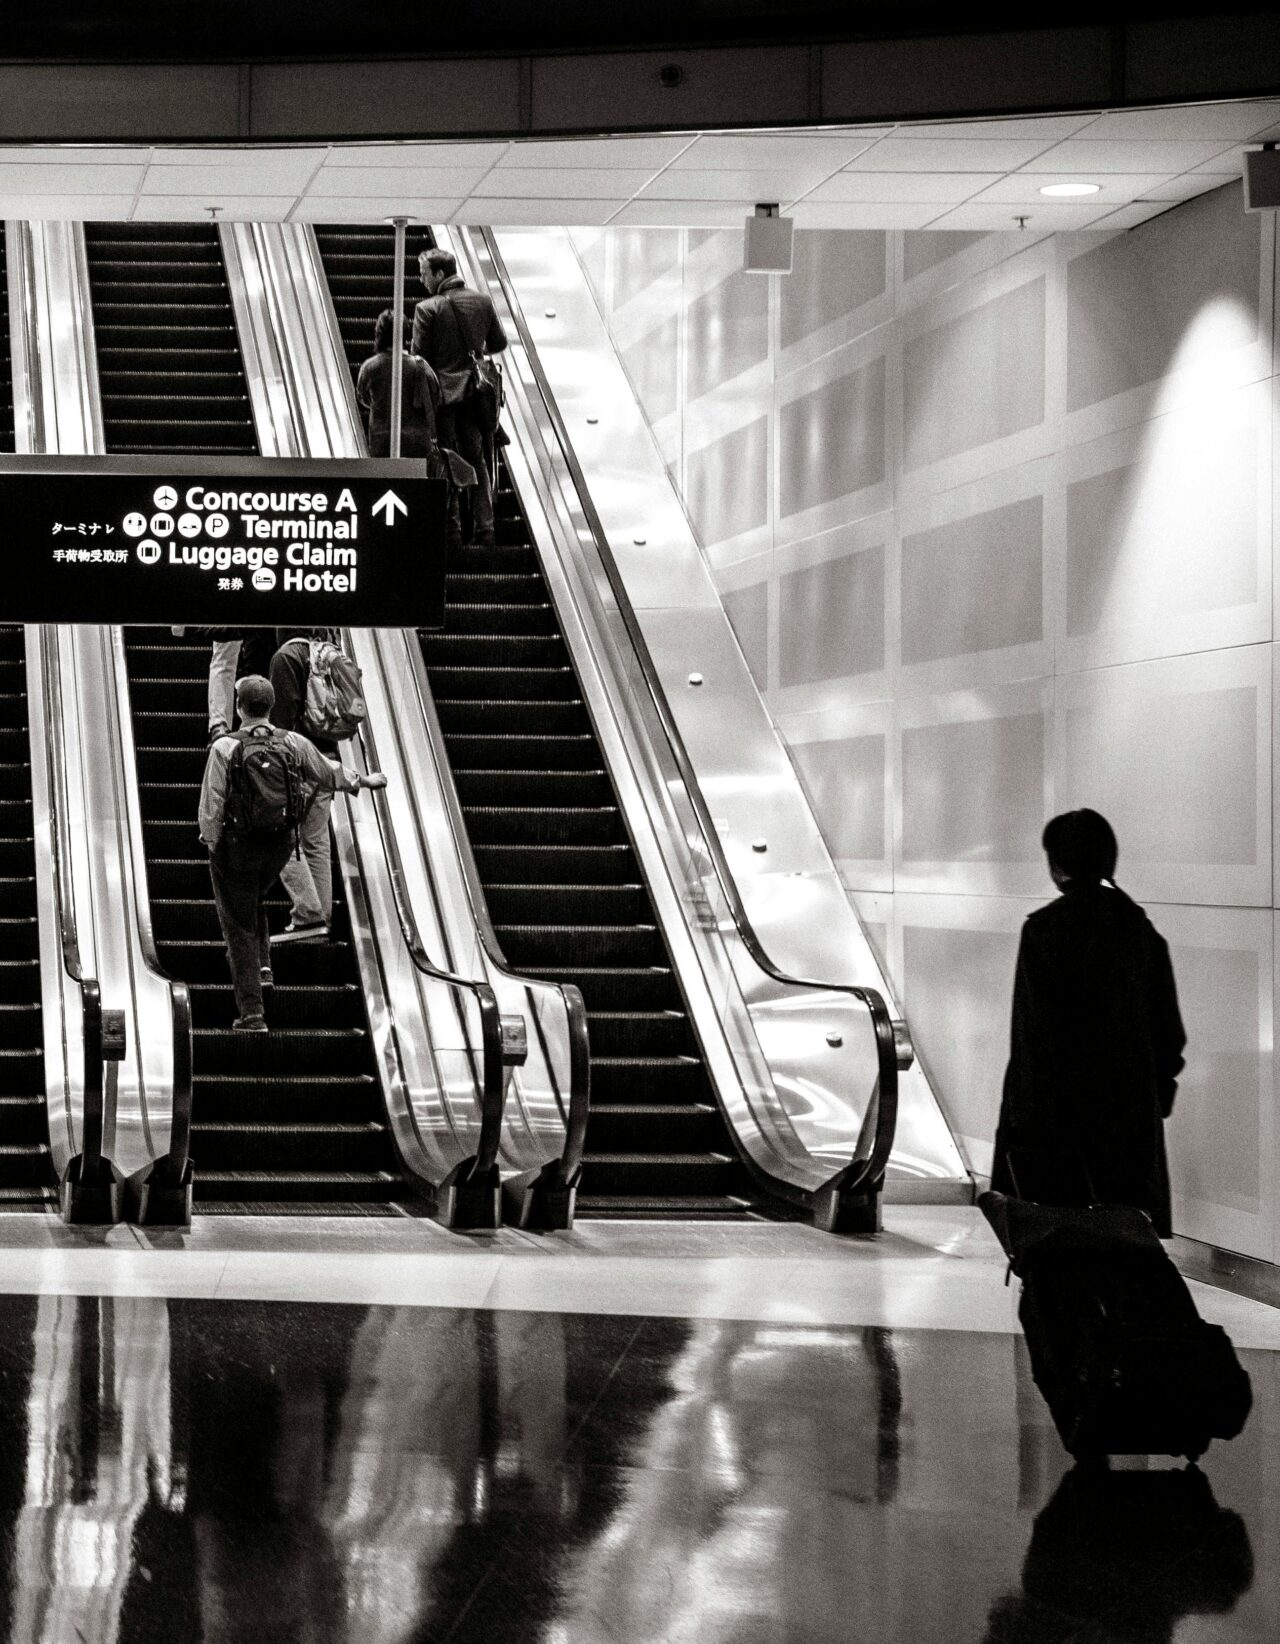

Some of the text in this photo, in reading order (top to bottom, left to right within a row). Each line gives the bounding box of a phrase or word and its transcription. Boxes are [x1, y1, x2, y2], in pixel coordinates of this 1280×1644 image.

[185, 486, 358, 513] Concourse A
[240, 513, 358, 540] Terminal
[51, 548, 129, 564] 手荷物受取所
[168, 541, 357, 571] Luggage Claim
[282, 567, 358, 593] Hotel
